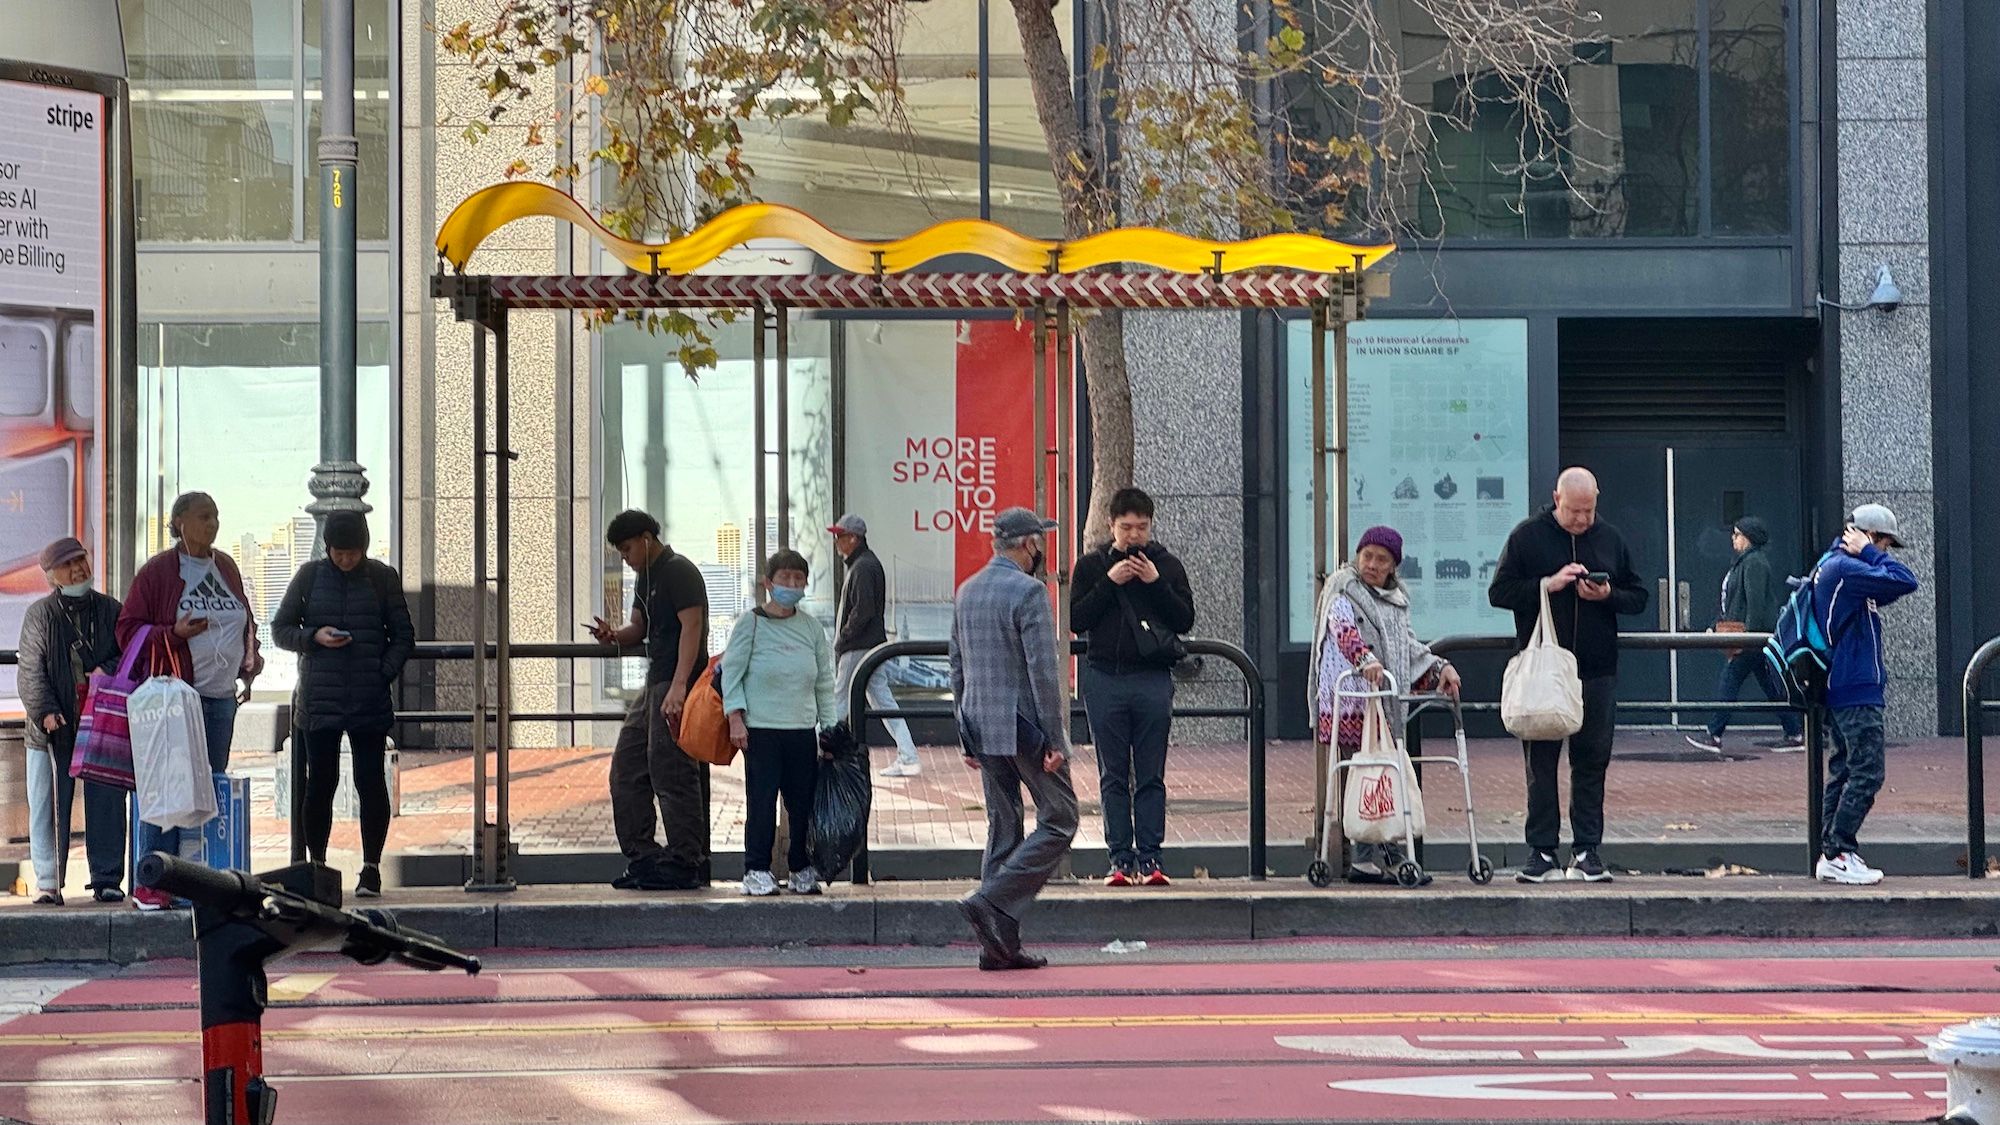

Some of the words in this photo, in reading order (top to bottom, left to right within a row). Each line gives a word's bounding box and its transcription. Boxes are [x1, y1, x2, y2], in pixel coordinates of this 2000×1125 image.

[47, 103, 94, 132] stripe
[20, 187, 36, 210] AI
[332, 168, 342, 209] 720
[15, 215, 48, 240] with
[18, 244, 65, 274] Billing
[1356, 347, 1367, 355] IN
[1369, 347, 1401, 355] UNION
[1403, 347, 1444, 356] SQUARE
[1446, 347, 1460, 355] SF
[1365, 336, 1375, 344] 10
[1377, 335, 1419, 345] Historical
[1421, 335, 1470, 345] Landmarks
[906, 437, 996, 460] MORE
[893, 461, 996, 484] SPACE
[957, 485, 996, 509] TO
[914, 509, 996, 533] LOVE
[180, 596, 244, 611] adidas
[217, 781, 228, 839] Lasko
